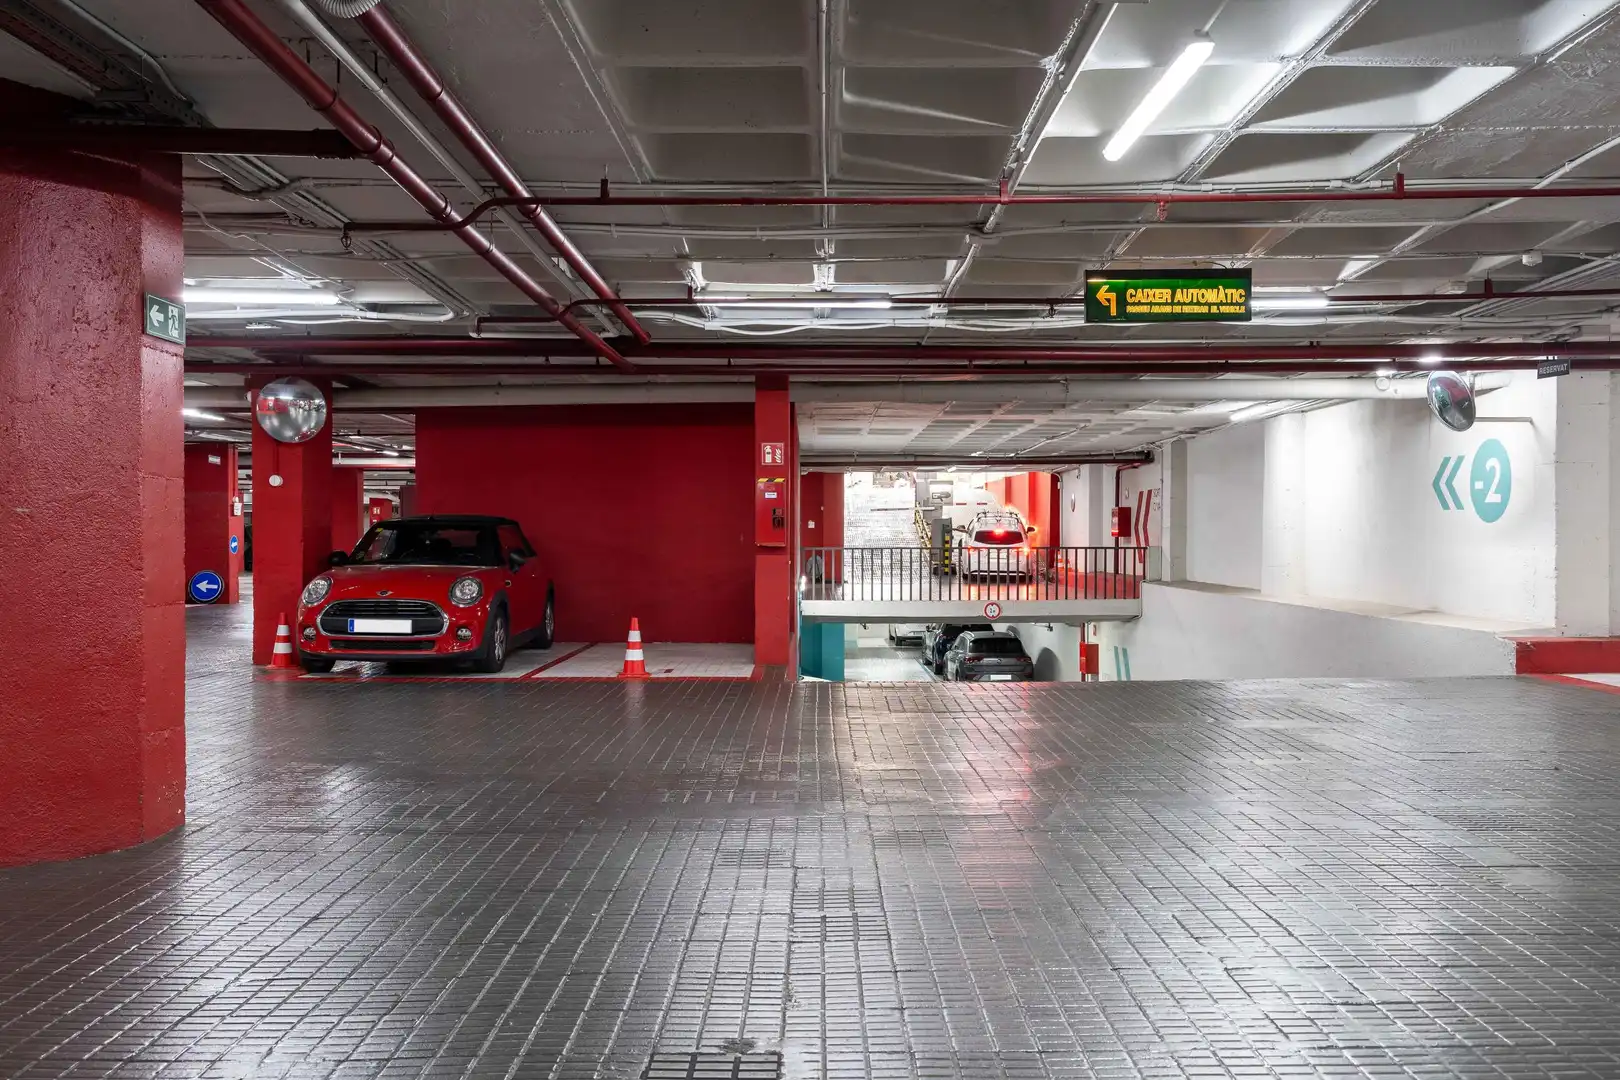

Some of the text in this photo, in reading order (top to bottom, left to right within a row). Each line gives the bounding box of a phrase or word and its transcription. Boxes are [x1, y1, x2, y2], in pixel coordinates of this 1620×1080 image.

[1126, 285, 1246, 303] CAIXER AUTOMÀTIC
[1539, 364, 1568, 375] RESERVAT
[1474, 457, 1502, 503] -2
